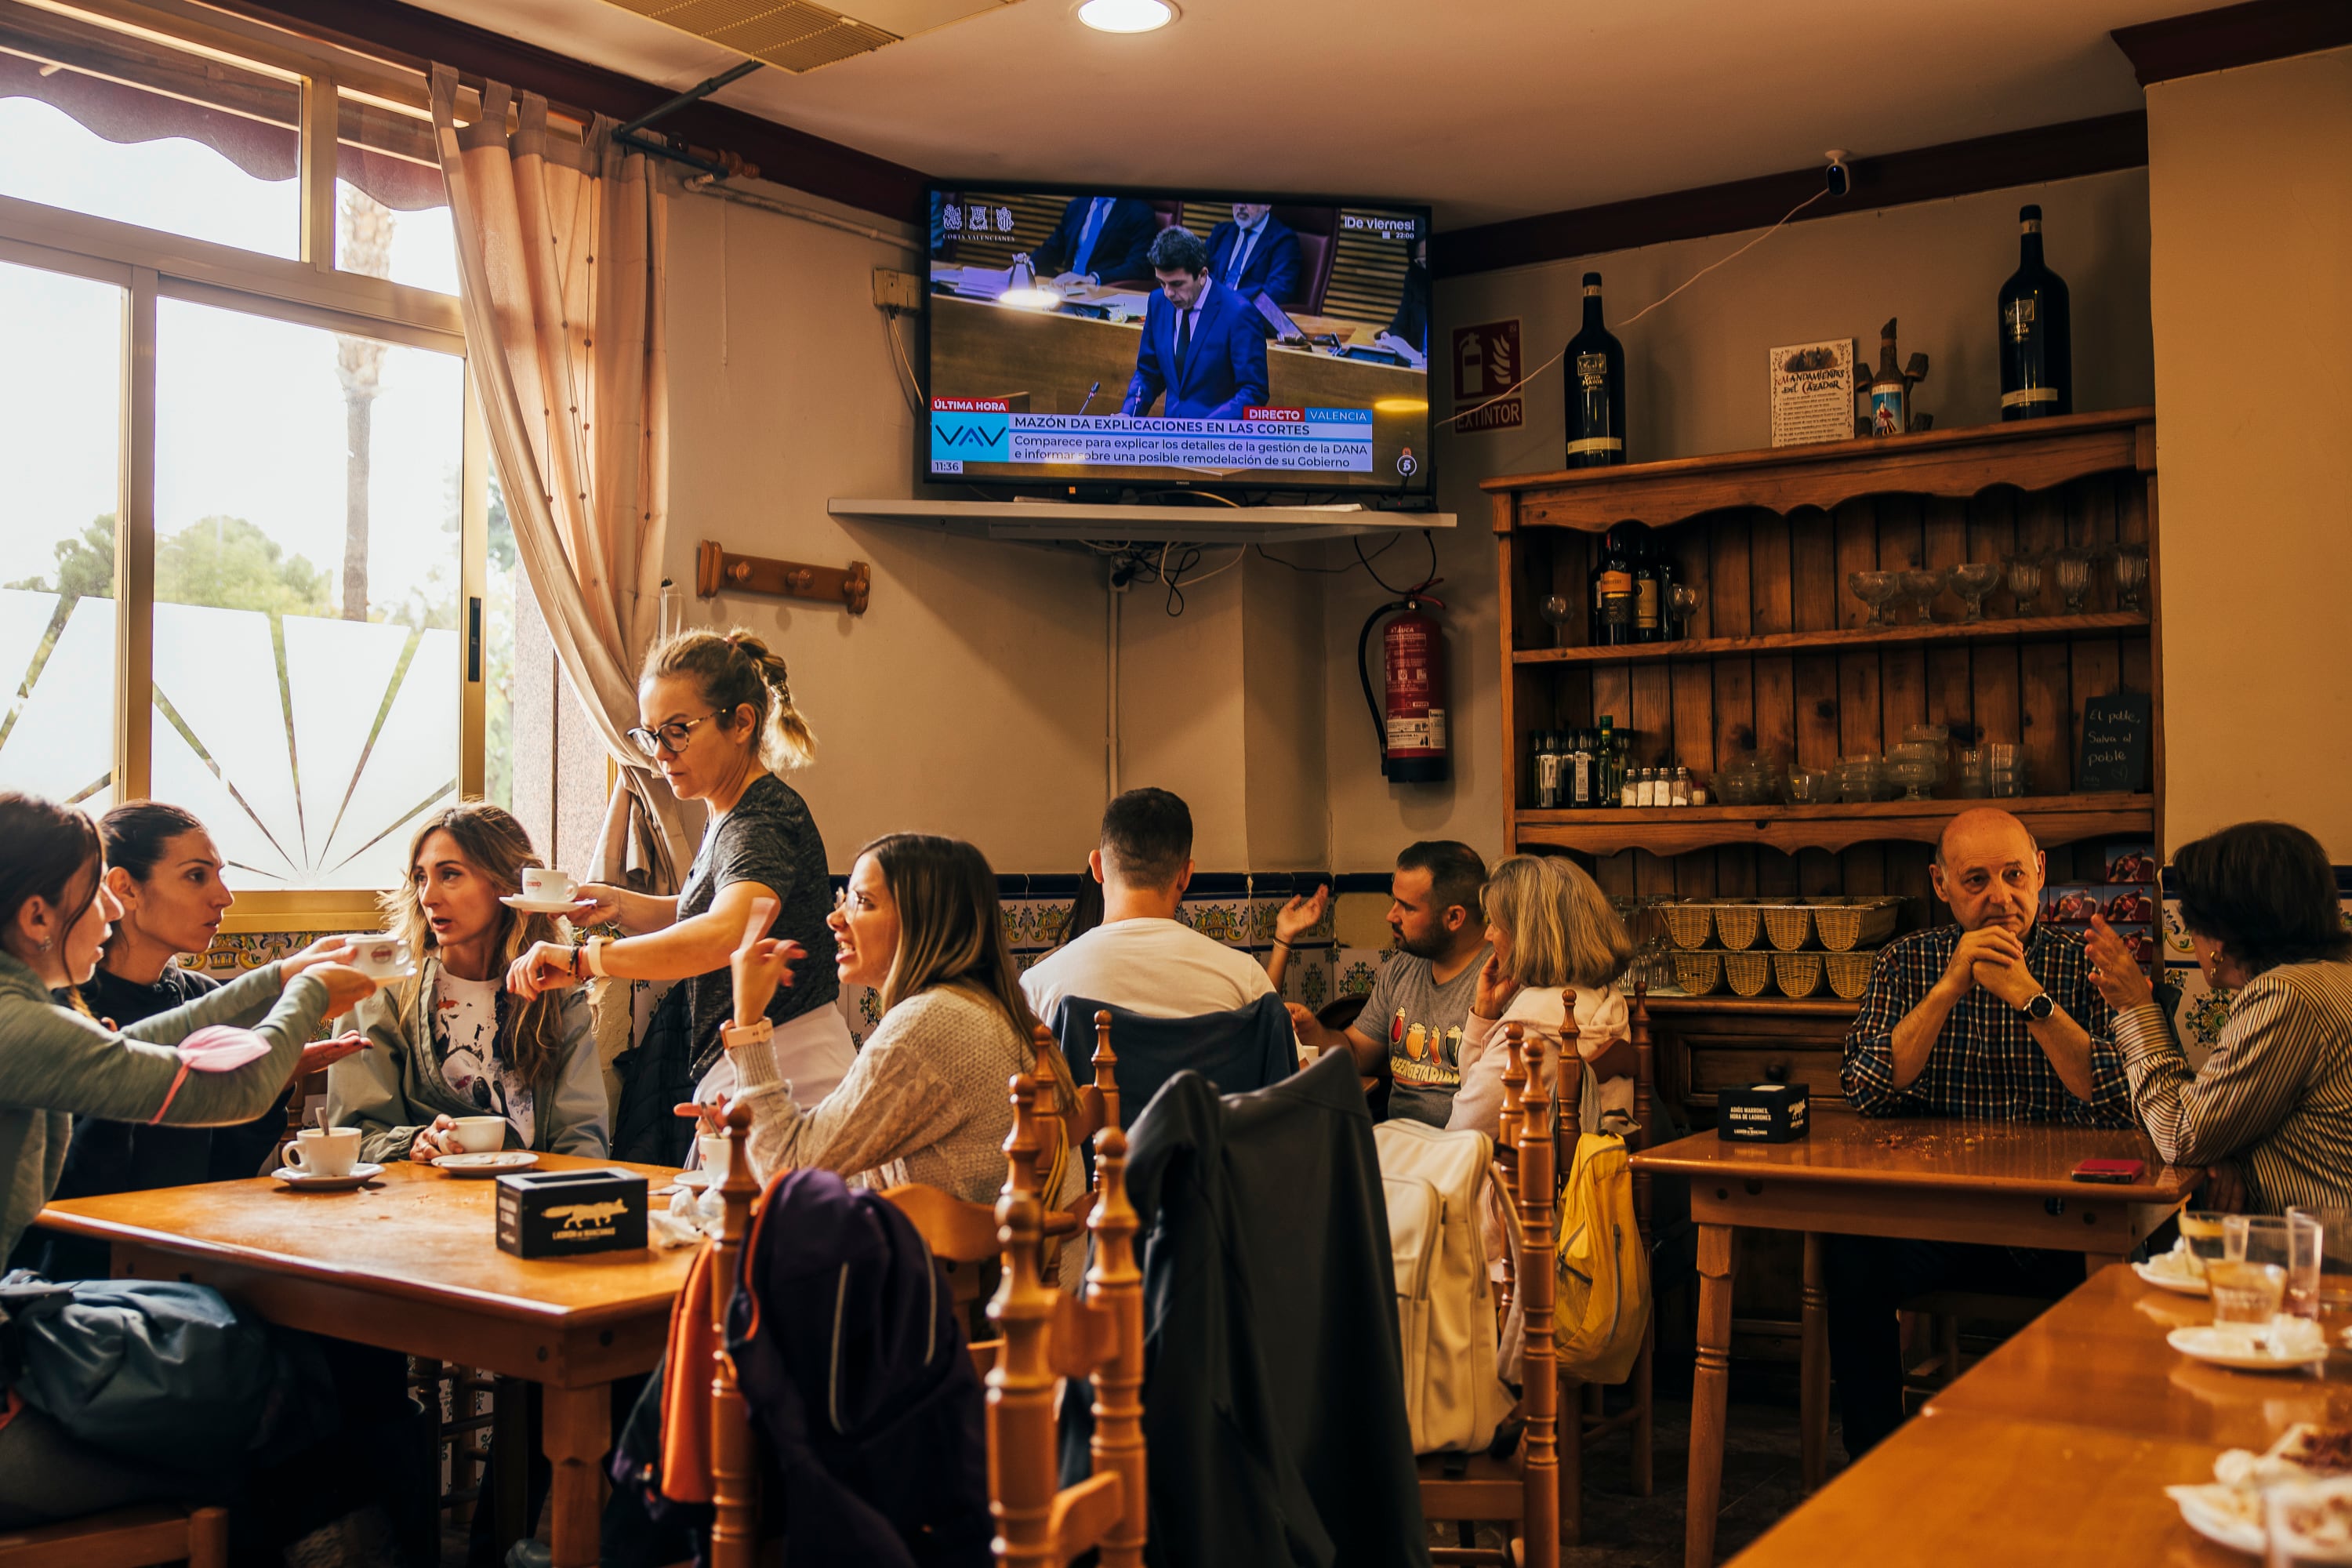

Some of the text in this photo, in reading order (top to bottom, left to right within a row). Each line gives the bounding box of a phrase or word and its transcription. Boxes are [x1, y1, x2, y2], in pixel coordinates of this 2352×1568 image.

[1367, 218, 1414, 230] viernes!
[934, 399, 1006, 412] ÚLTIMA HORA
[1249, 409, 1367, 422] DIRECTO VALENCIA
[1456, 402, 1520, 429] EXTINTOR
[1014, 414, 1310, 436] MAZÓN DA EXPLICACIONES EN LAS CORTES
[1014, 435, 1367, 455] Comparece para explicar los detalles de la gestión de la DANA
[1025, 448, 1074, 460] informar
[1078, 451, 1110, 461] sobre
[1114, 453, 1136, 462] una
[1138, 452, 1179, 464] posible
[1182, 453, 1261, 466] remodelación
[1265, 456, 1279, 466] de
[1298, 456, 1350, 467] Gobierno
[935, 463, 960, 471] 11:36
[2089, 709, 2102, 721] El
[2088, 731, 2132, 744] Salva al
[2087, 750, 2127, 767] poble
